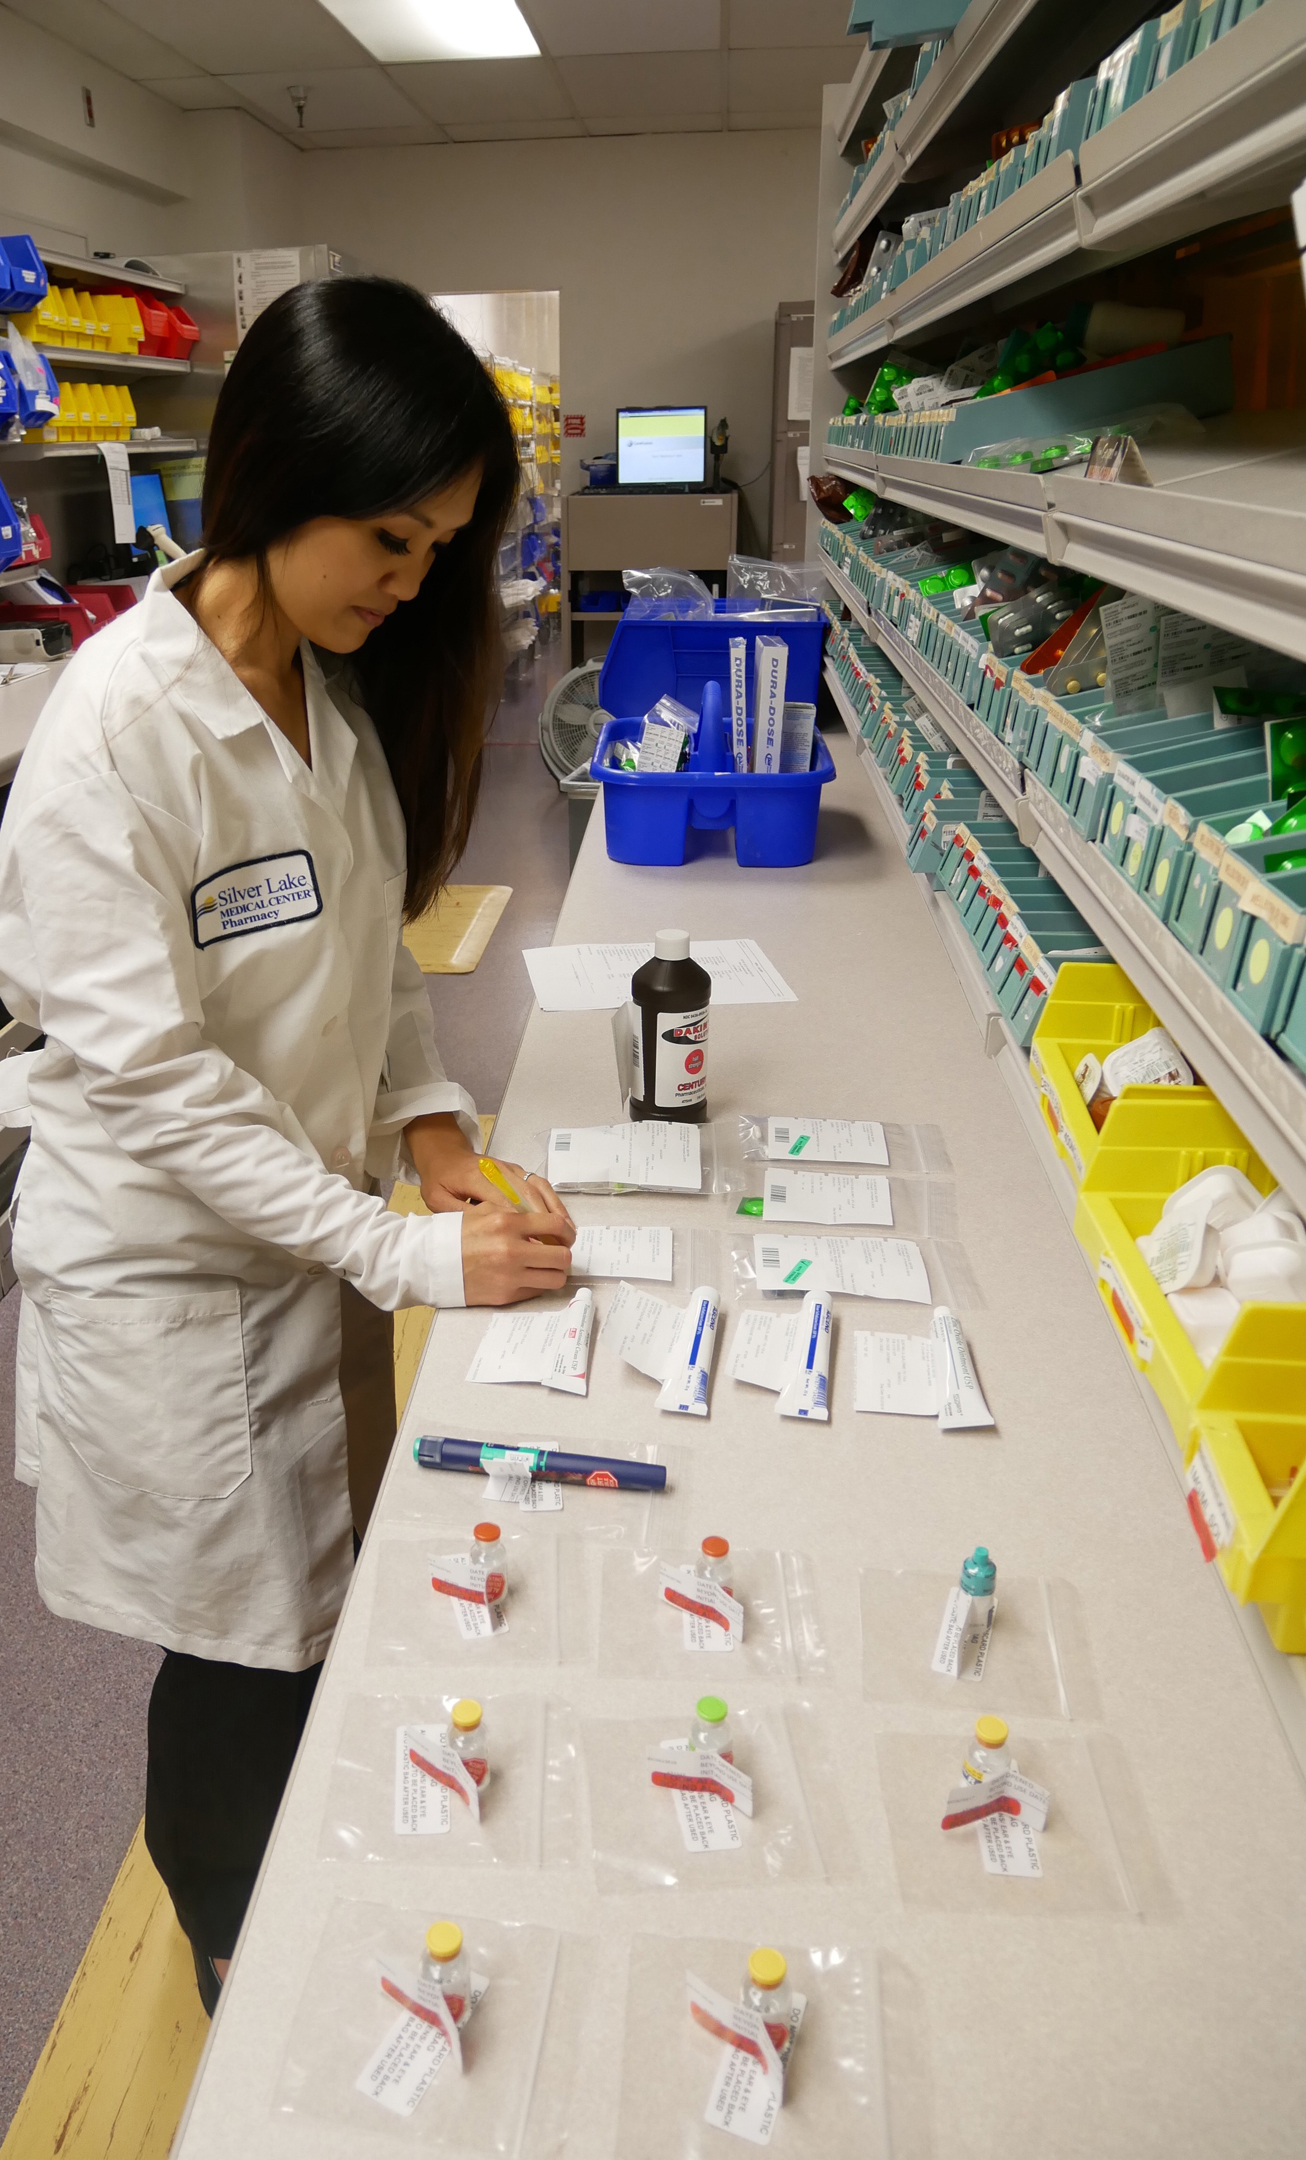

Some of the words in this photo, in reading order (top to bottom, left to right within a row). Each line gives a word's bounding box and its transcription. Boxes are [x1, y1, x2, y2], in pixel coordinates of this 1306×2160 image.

[218, 885, 263, 907] Silver
[265, 873, 308, 894] Lake
[220, 902, 269, 919] MEDICAL
[268, 889, 312, 907] CENTER
[221, 910, 280, 930] Pharmacy
[678, 1076, 707, 1092] CENTUR
[708, 1305, 718, 1331] ASCEND
[957, 1345, 970, 1375] Ointment
[552, 1488, 563, 1506] PLASTIC
[696, 1588, 718, 1597] BEYON
[458, 1602, 469, 1618] AFTER
[465, 1602, 478, 1623] PLACED
[477, 1614, 486, 1625] EYE
[492, 1603, 507, 1628] PLASTIC
[462, 1617, 473, 1632] USED
[471, 1621, 483, 1637] BACK
[704, 1629, 712, 1639] EYE
[945, 1623, 954, 1636] BAG
[689, 1629, 697, 1643] USED
[697, 1635, 705, 1650] BACK
[942, 1635, 951, 1650] AFTER
[938, 1650, 947, 1664] USED
[948, 1638, 959, 1659] PLACED
[945, 1658, 954, 1673] BACK
[974, 1650, 986, 1678] PLASTIC
[411, 1779, 417, 1788] BE
[688, 1794, 697, 1804] BE
[707, 1791, 717, 1803] AG
[440, 1795, 448, 1825] PLASTIC
[681, 1801, 694, 1823] AFTER
[690, 1804, 705, 1831] PLACED
[698, 1800, 709, 1815] EAR
[704, 1820, 714, 1835] EYE
[722, 1808, 739, 1842] PLASTIC
[989, 1816, 998, 1826] BE
[1010, 1816, 1019, 1829] AG
[687, 1823, 699, 1842] USED
[698, 1830, 710, 1850] BACK
[981, 1822, 993, 1845] AFTER
[987, 1844, 997, 1863] USED
[991, 1826, 1004, 1853] PLACED
[1000, 1824, 1009, 1839] EAR
[1005, 1845, 1014, 1859] EYE
[997, 1853, 1009, 1873] BACK
[1024, 1836, 1040, 1871] PLASTIC
[400, 2015, 416, 2034] BAG
[733, 2014, 761, 2031] BEYON
[789, 2007, 801, 2023] DO
[407, 2029, 419, 2043] BE
[425, 2031, 444, 2054] BAG
[383, 2033, 404, 2060] AFTER
[406, 2042, 422, 2061] EAR
[430, 2039, 452, 2067] CARD
[386, 2041, 411, 2075] PLACED
[402, 2060, 411, 2069] &
[740, 2056, 750, 2068] BE
[369, 2058, 388, 2082] USED
[391, 2067, 407, 2086] EYE
[722, 2060, 737, 2087] AFTER
[745, 2068, 757, 2087] EAR
[371, 2073, 391, 2099] BACK
[404, 2066, 437, 2109] PLASTIC
[729, 2068, 746, 2102] PLACED
[715, 2087, 729, 2112] USED
[737, 2095, 749, 2113] EYE
[721, 2102, 736, 2128] BACK
